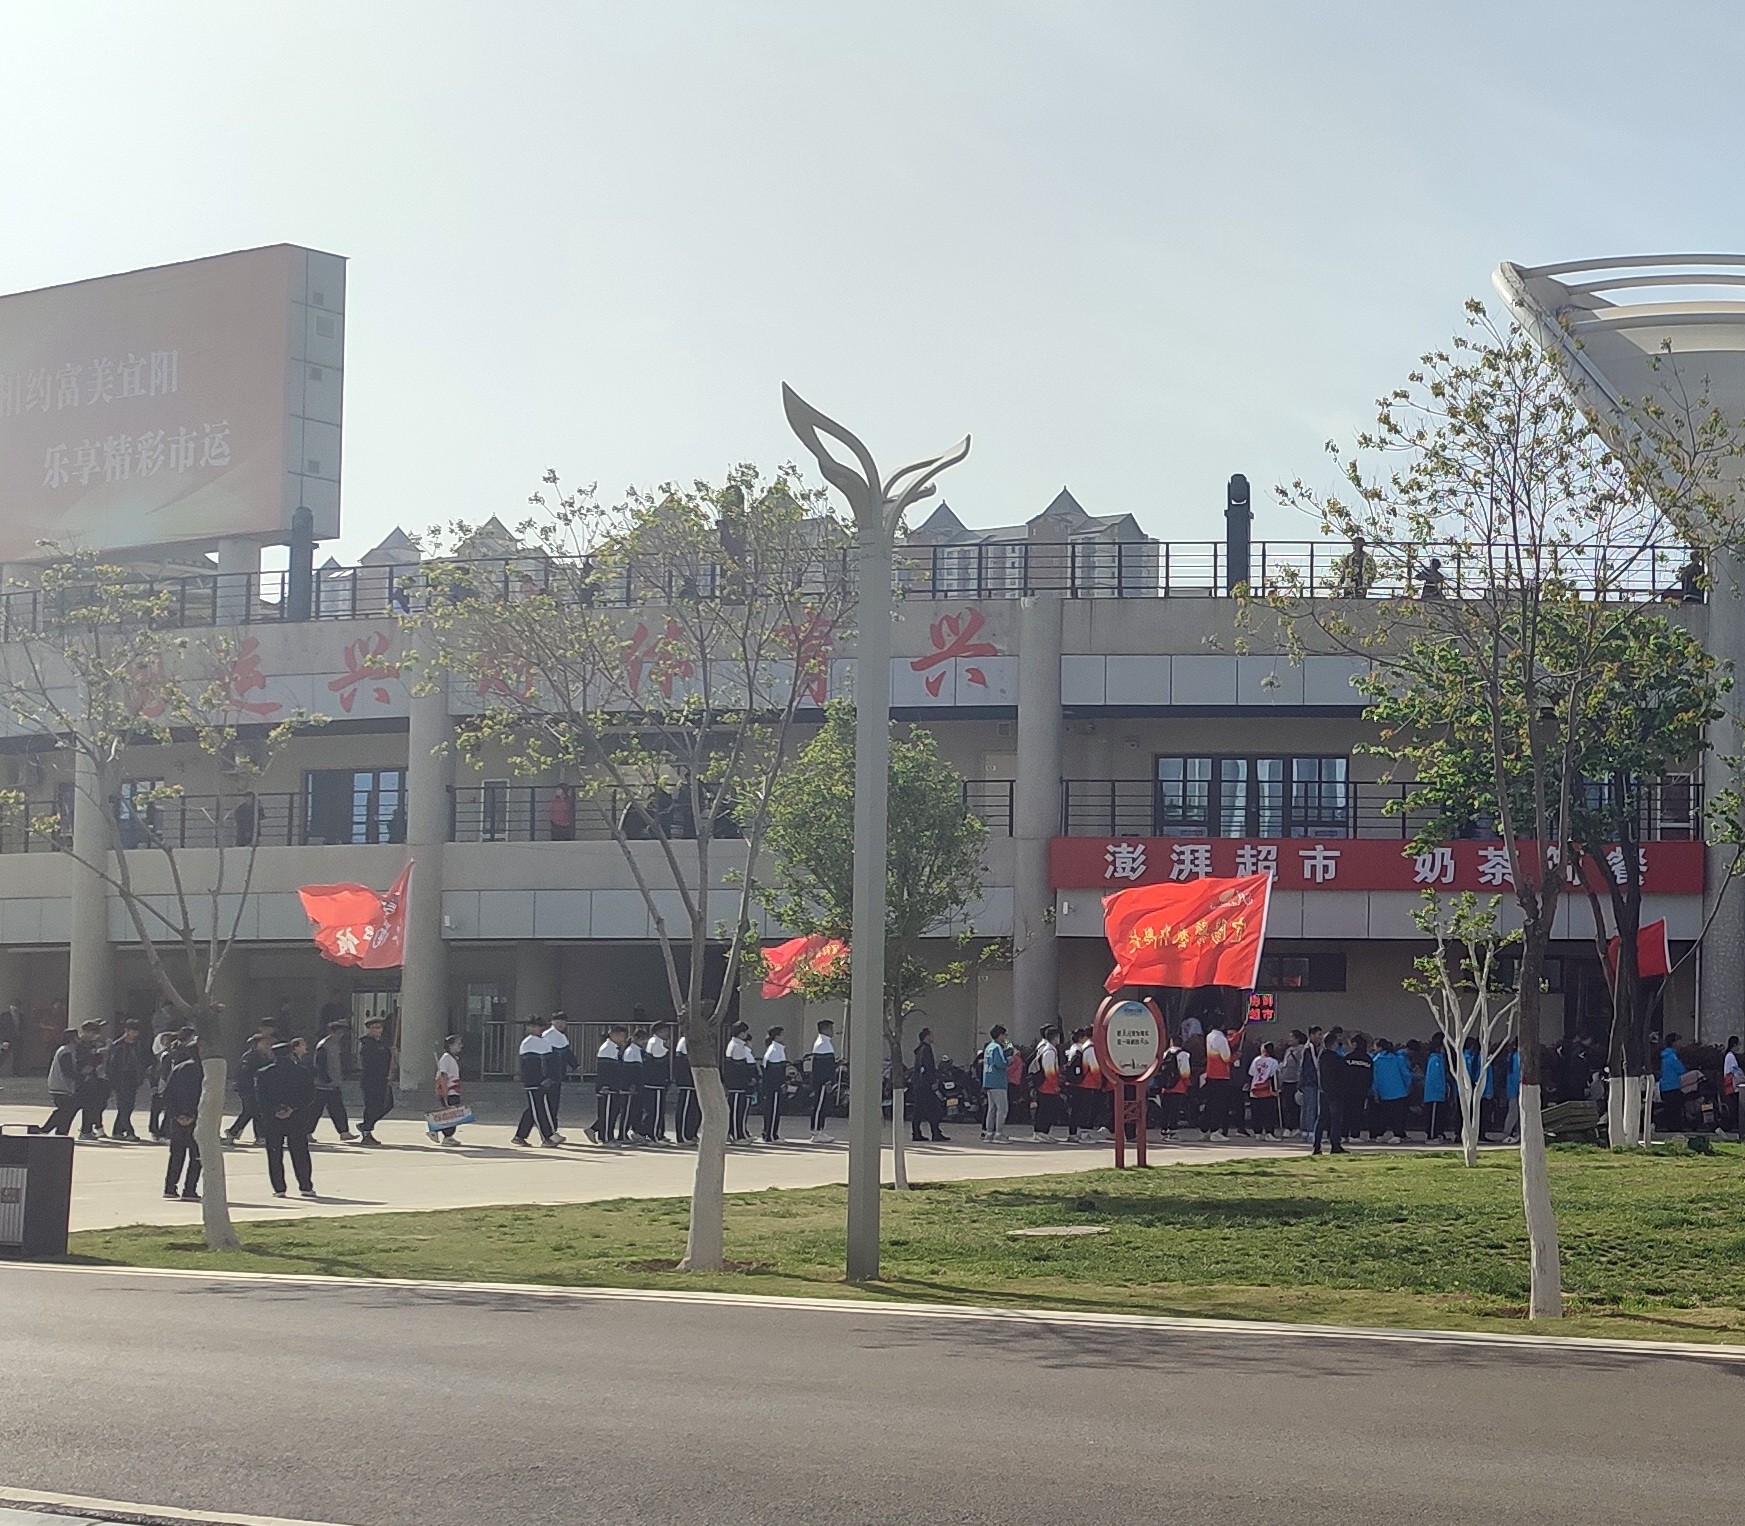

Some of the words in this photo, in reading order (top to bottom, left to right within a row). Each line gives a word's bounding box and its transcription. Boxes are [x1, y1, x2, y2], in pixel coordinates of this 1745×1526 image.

[43, 418, 232, 489] 乐享精彩市运
[1103, 843, 1341, 883] 澎湃超市
